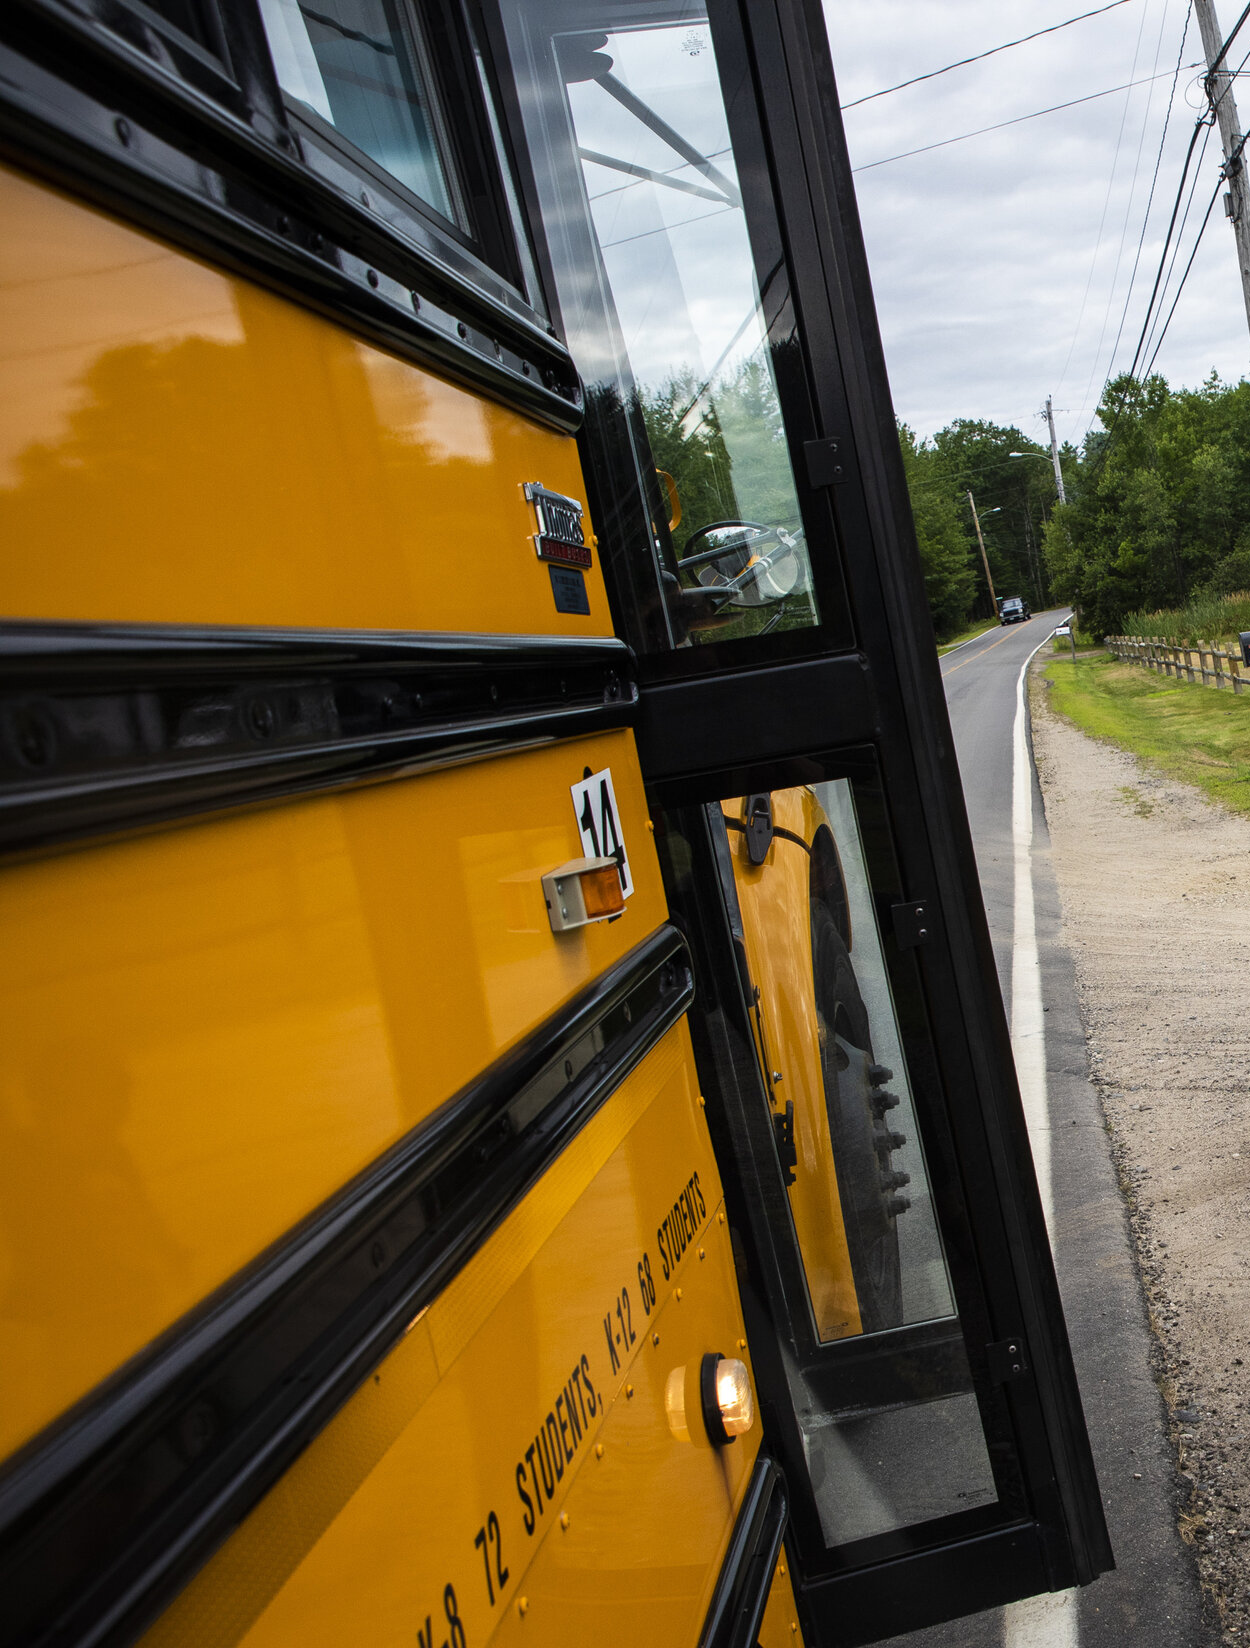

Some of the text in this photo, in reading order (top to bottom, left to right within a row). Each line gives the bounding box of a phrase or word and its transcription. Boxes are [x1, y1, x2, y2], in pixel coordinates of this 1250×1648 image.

[580, 779, 627, 891] 14
[475, 1510, 509, 1607] 72
[515, 1354, 604, 1536] STUDENTS,
[604, 1287, 636, 1376] K-12
[638, 1252, 656, 1317] 68
[657, 1171, 707, 1281] STUDENTS
